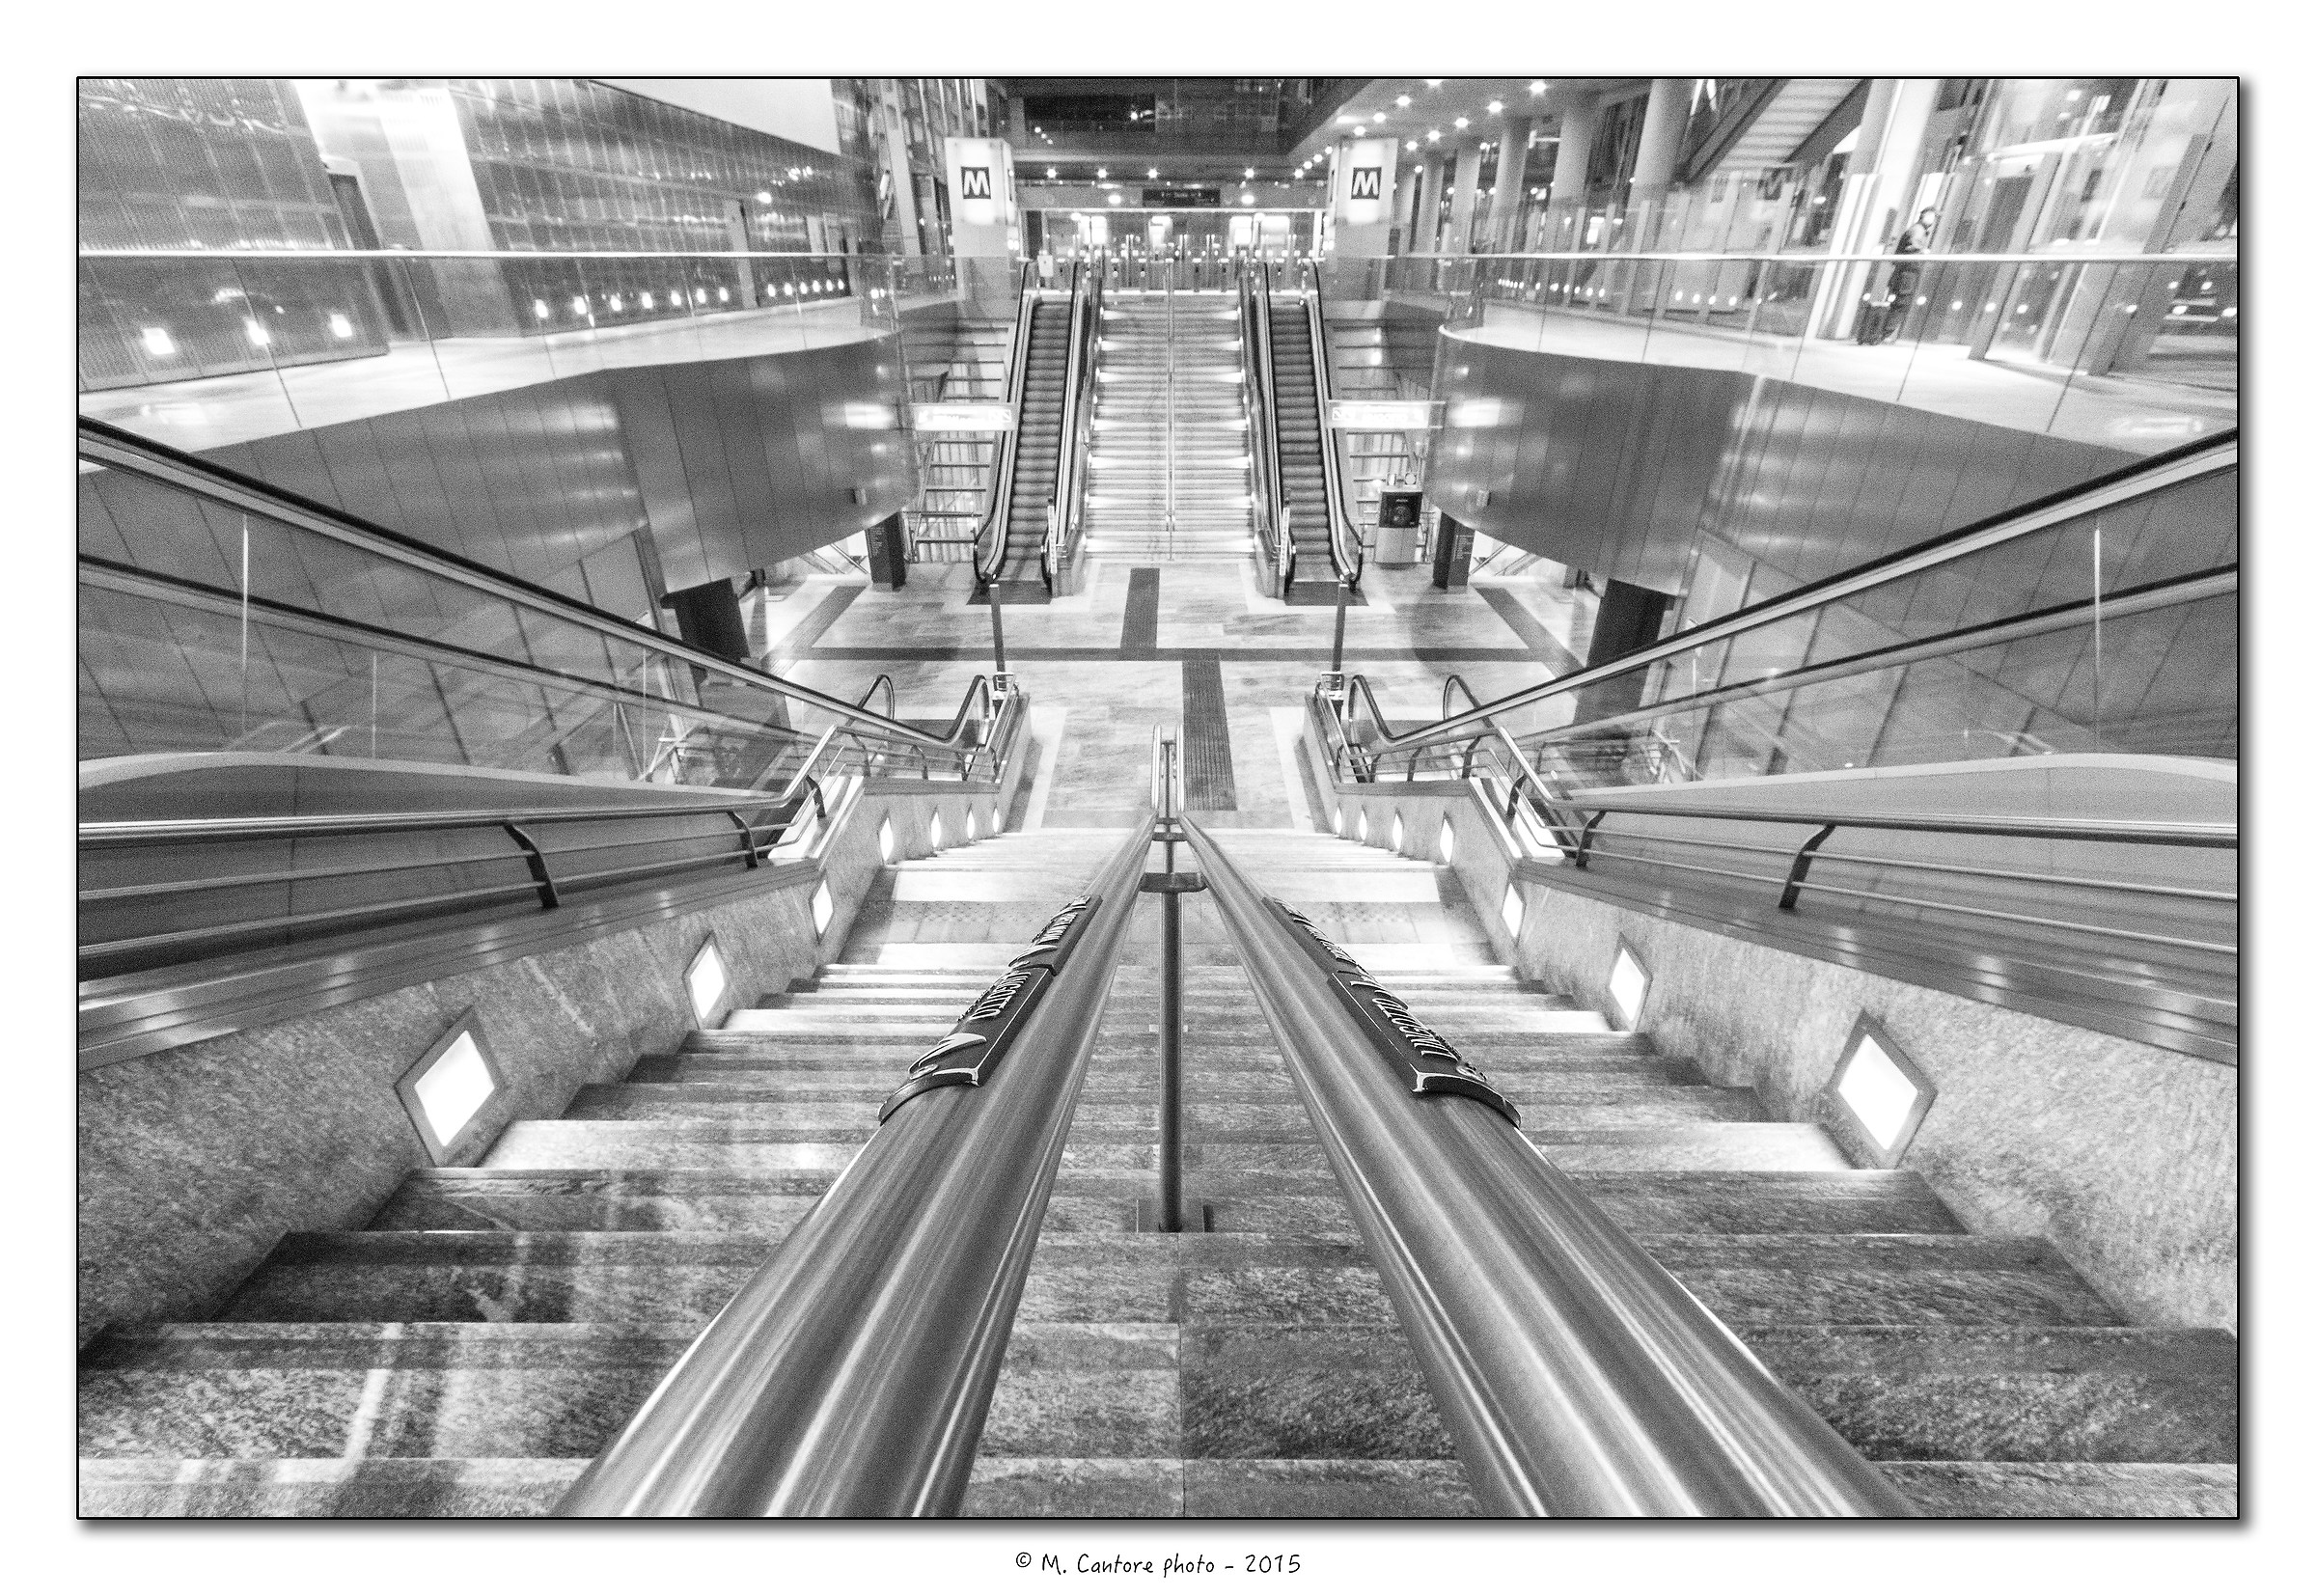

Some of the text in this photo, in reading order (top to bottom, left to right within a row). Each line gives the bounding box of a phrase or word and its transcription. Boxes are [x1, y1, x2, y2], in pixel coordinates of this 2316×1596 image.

[964, 170, 990, 196] M
[1352, 171, 1379, 196] M
[1372, 998, 1459, 1060] LINGOTTO
